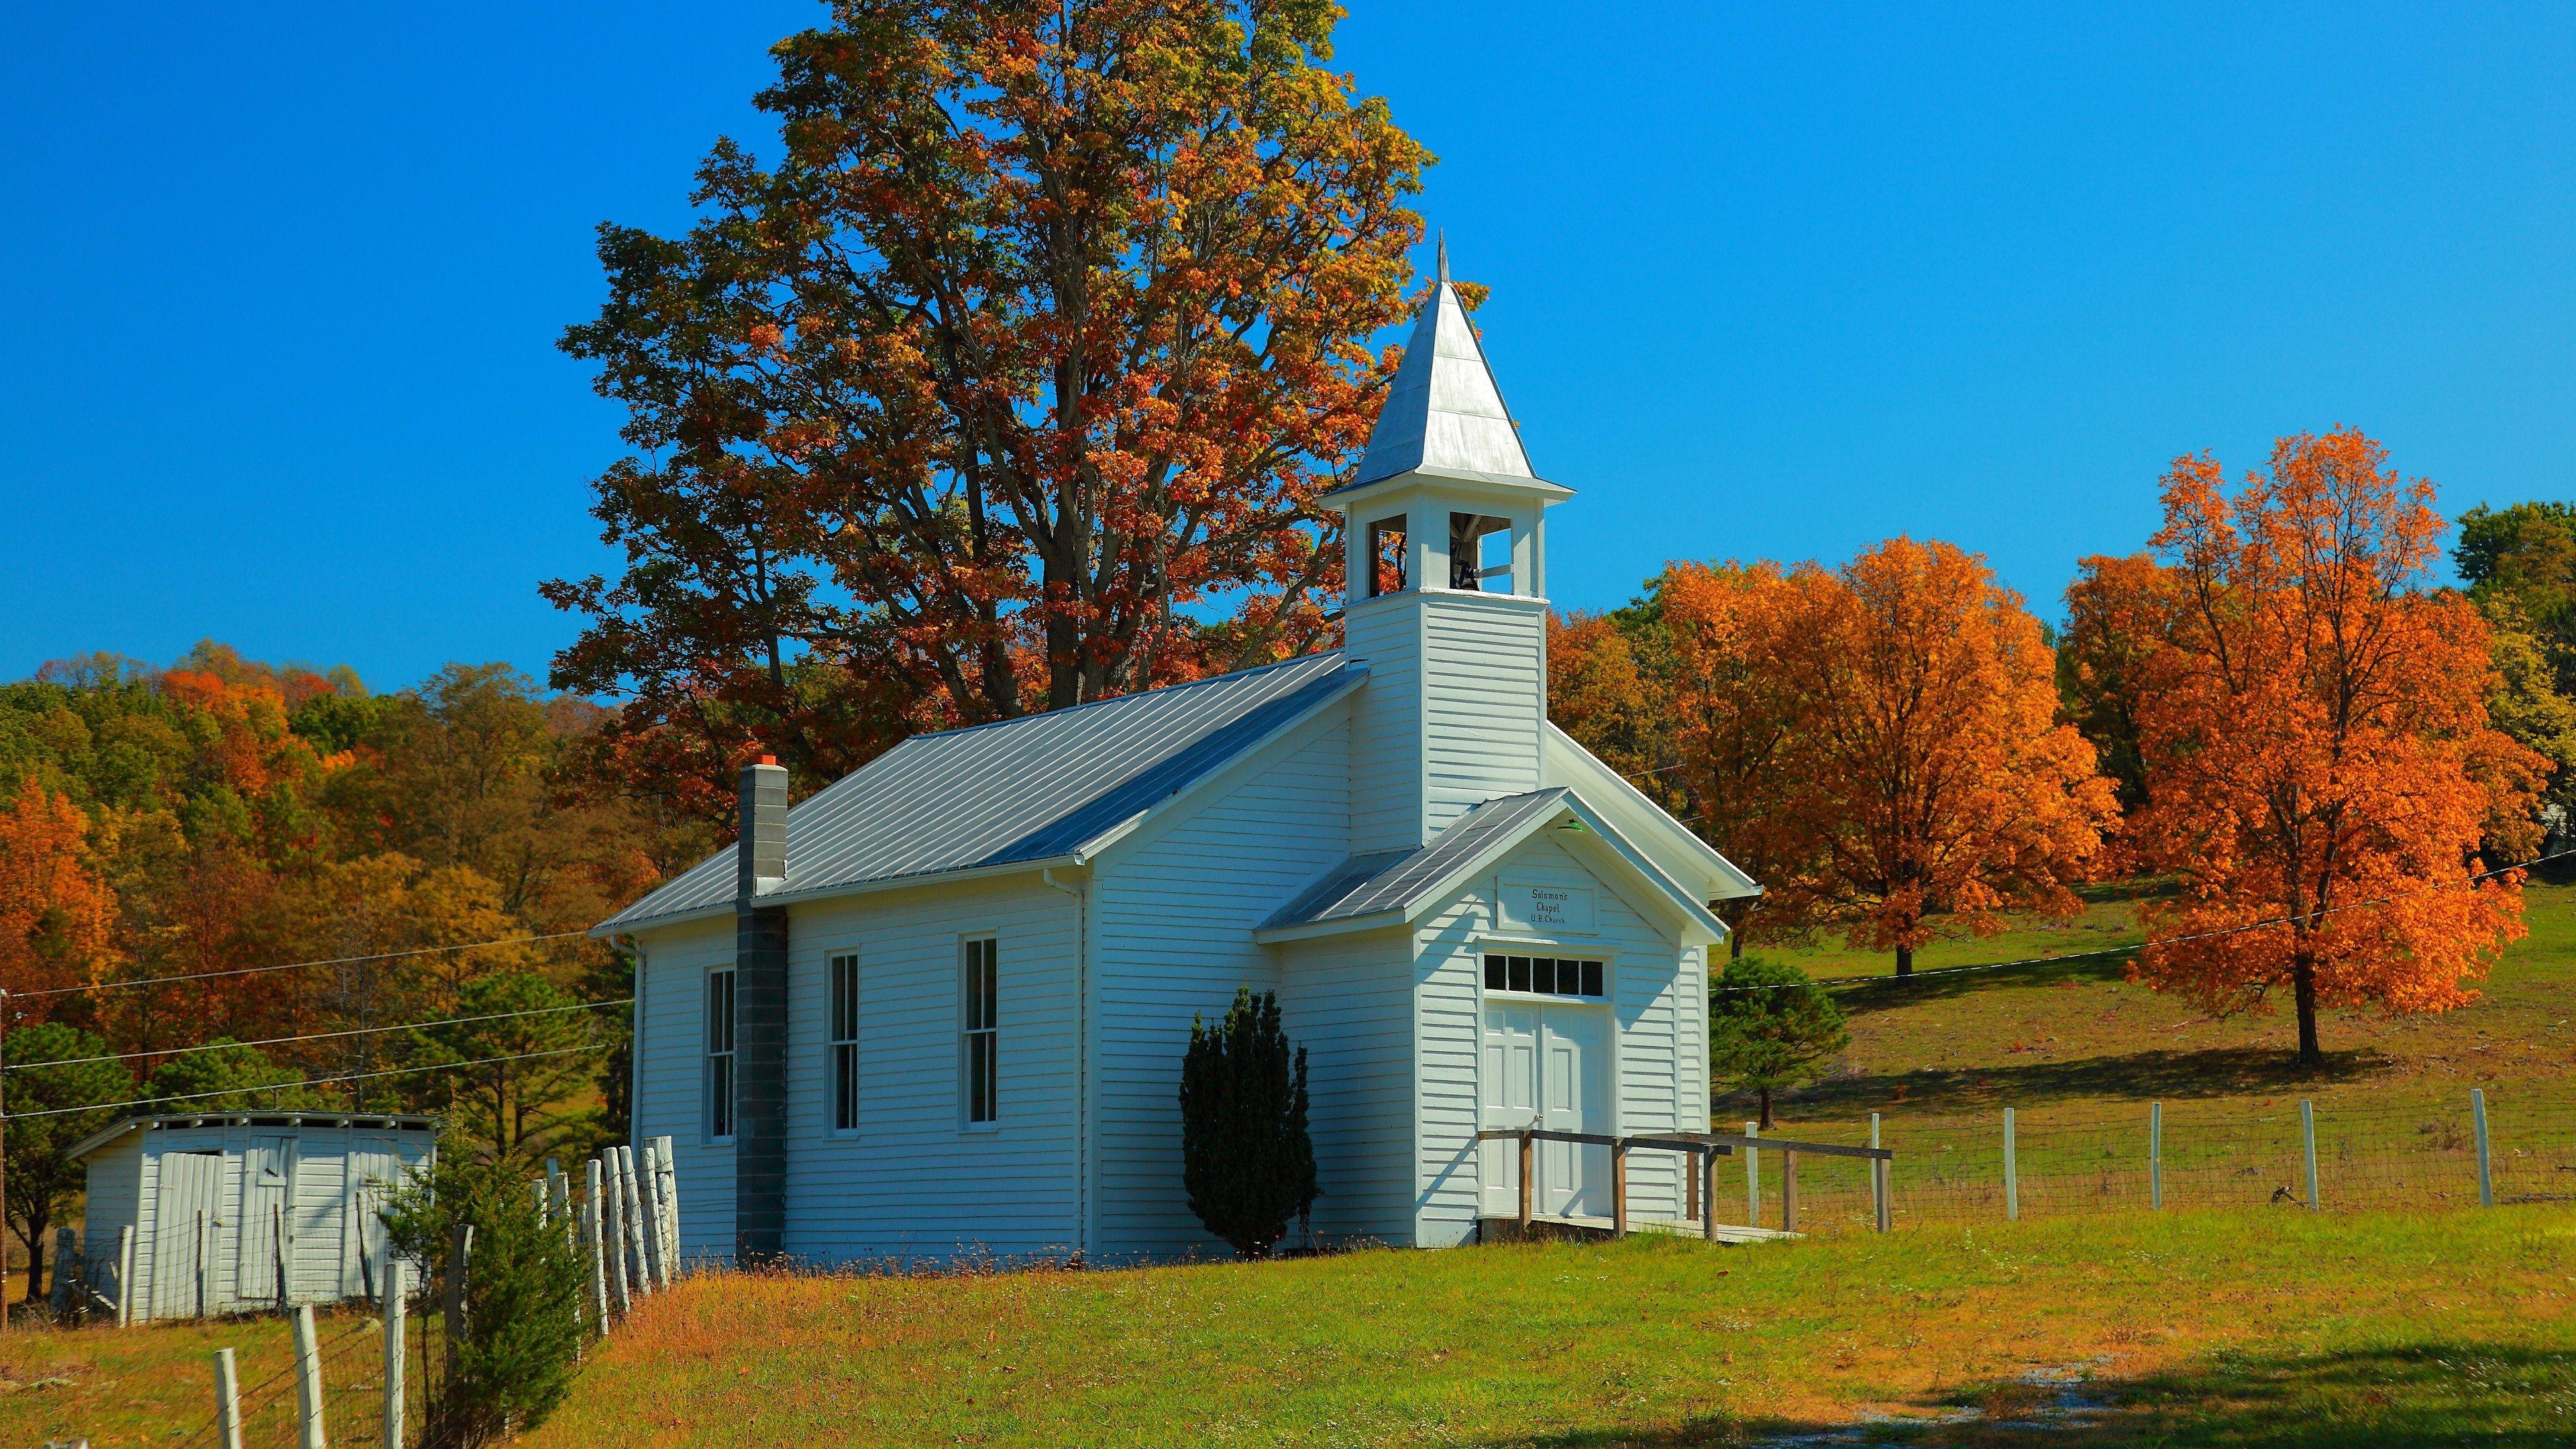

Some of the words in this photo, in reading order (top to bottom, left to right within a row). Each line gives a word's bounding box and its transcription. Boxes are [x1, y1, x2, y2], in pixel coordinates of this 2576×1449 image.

[1532, 890, 1567, 900] Solomon's
[1537, 902, 1560, 914] Chapel
[1545, 916, 1564, 924] Church
